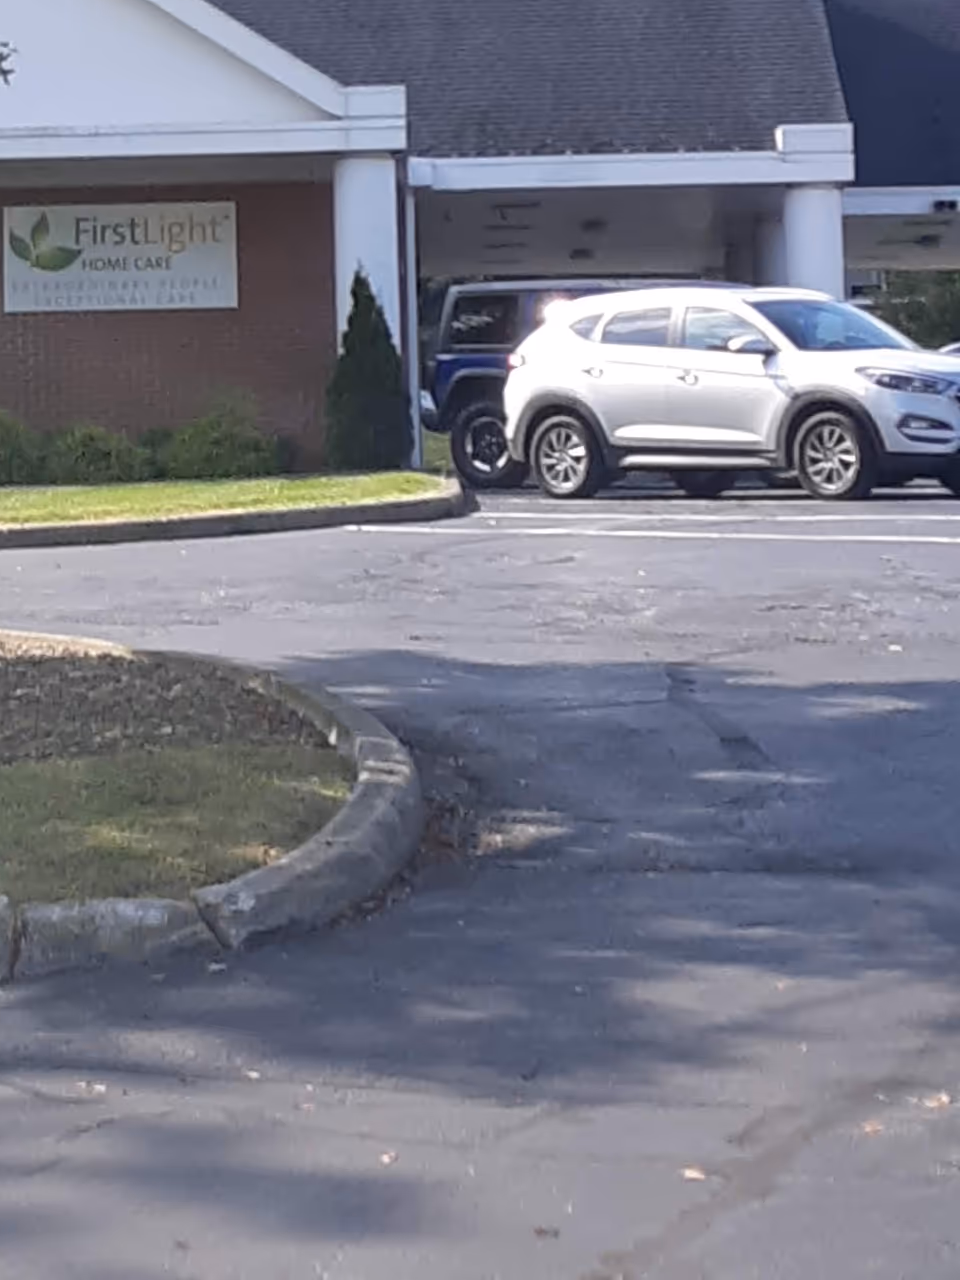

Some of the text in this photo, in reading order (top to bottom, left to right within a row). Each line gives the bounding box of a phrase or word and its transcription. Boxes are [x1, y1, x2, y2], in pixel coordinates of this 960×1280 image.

[74, 214, 222, 254] FirstLight
[81, 256, 173, 272] HOME CARE
